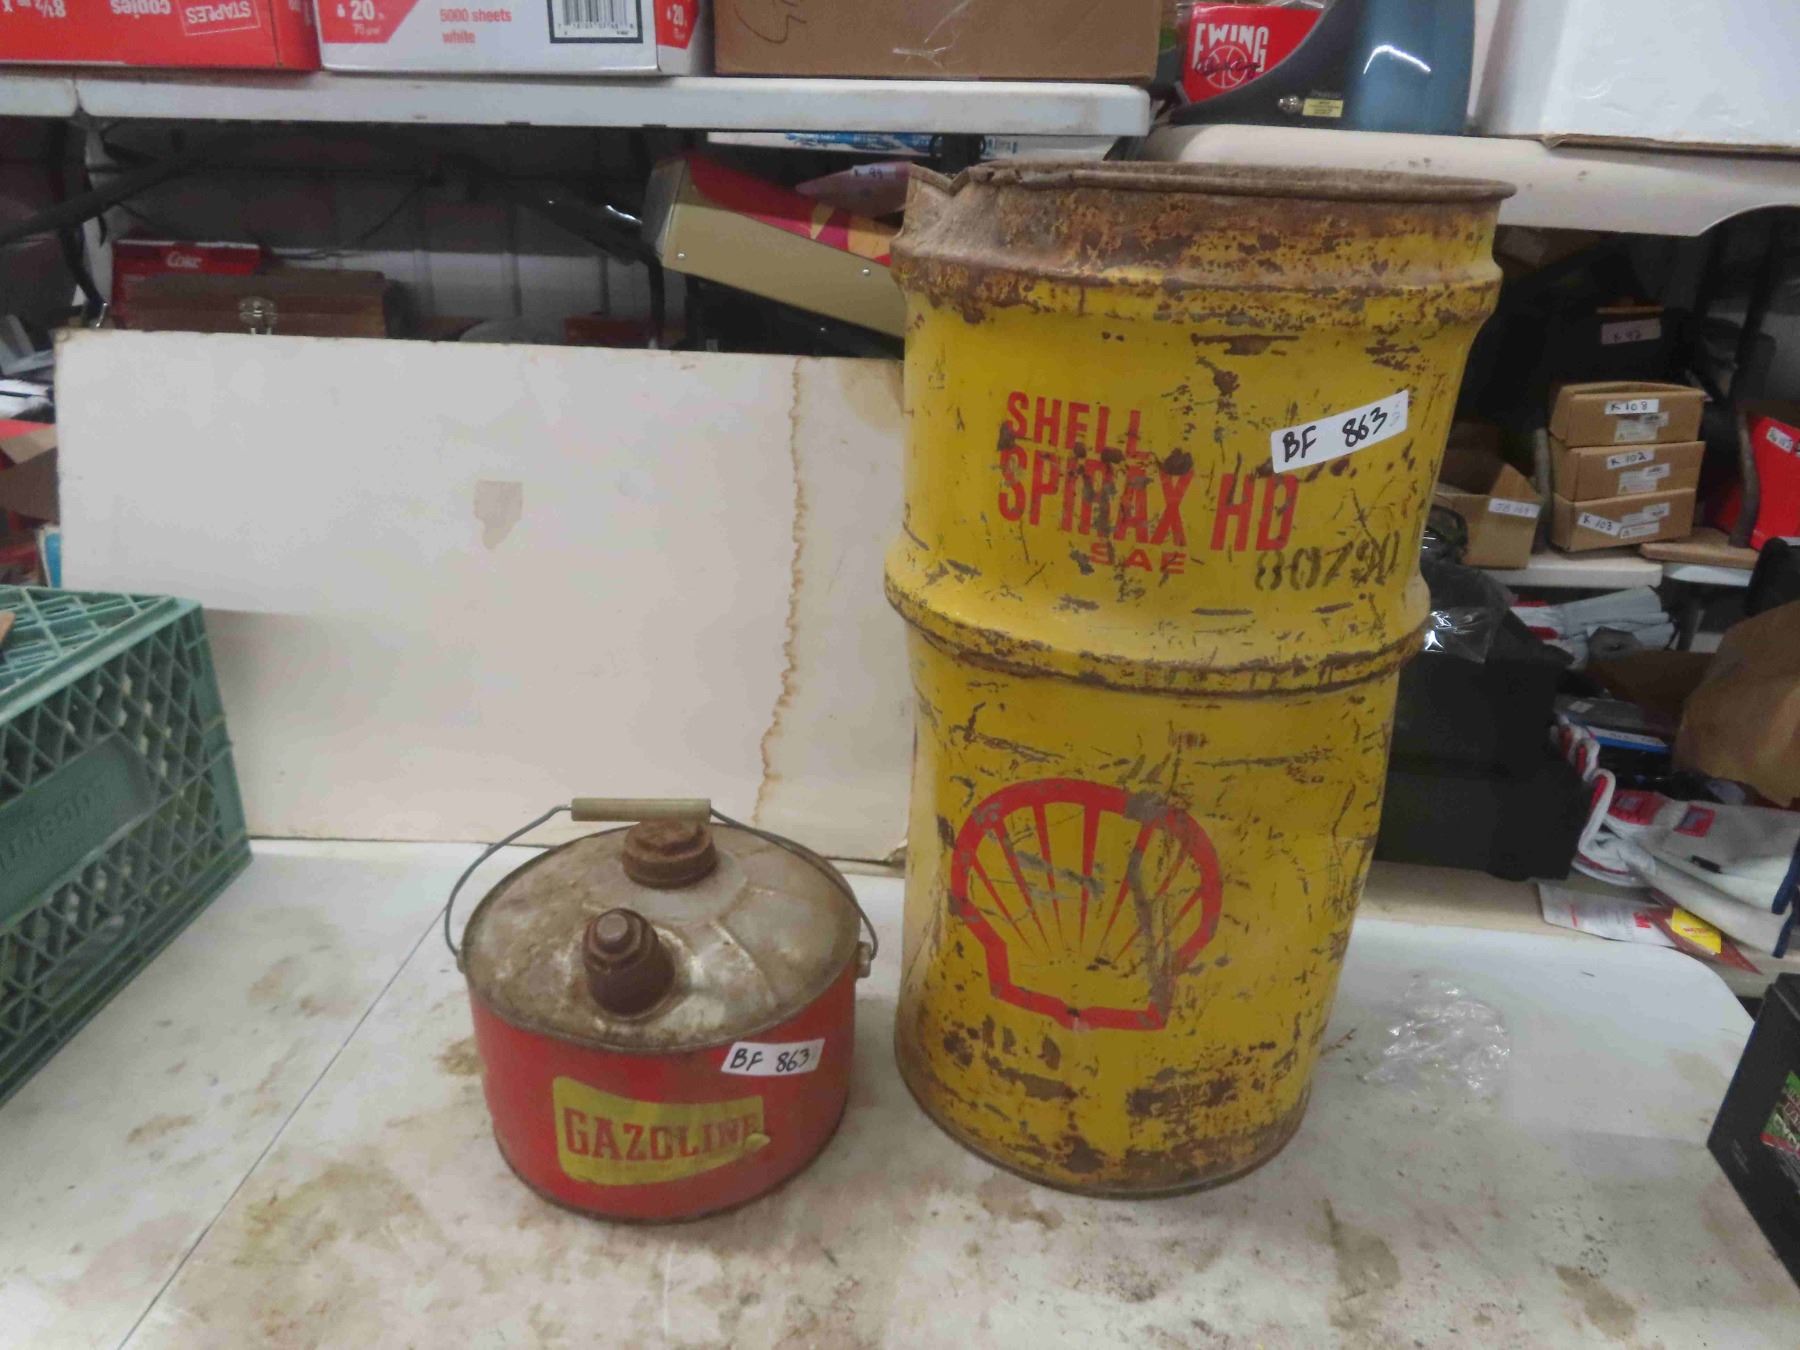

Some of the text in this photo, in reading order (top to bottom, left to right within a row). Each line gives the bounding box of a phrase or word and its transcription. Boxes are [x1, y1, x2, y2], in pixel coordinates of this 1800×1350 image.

[186, 0, 251, 24] STAPLES
[351, 0, 376, 20] 20
[440, 9, 512, 22] 5000 sheets
[443, 30, 476, 43] white
[1192, 23, 1269, 73] EWING
[1007, 391, 1151, 461] SHELL
[1283, 406, 1389, 462] BF 863
[998, 444, 1298, 552] SPIRAX HD
[730, 1048, 810, 1073] BF 863
